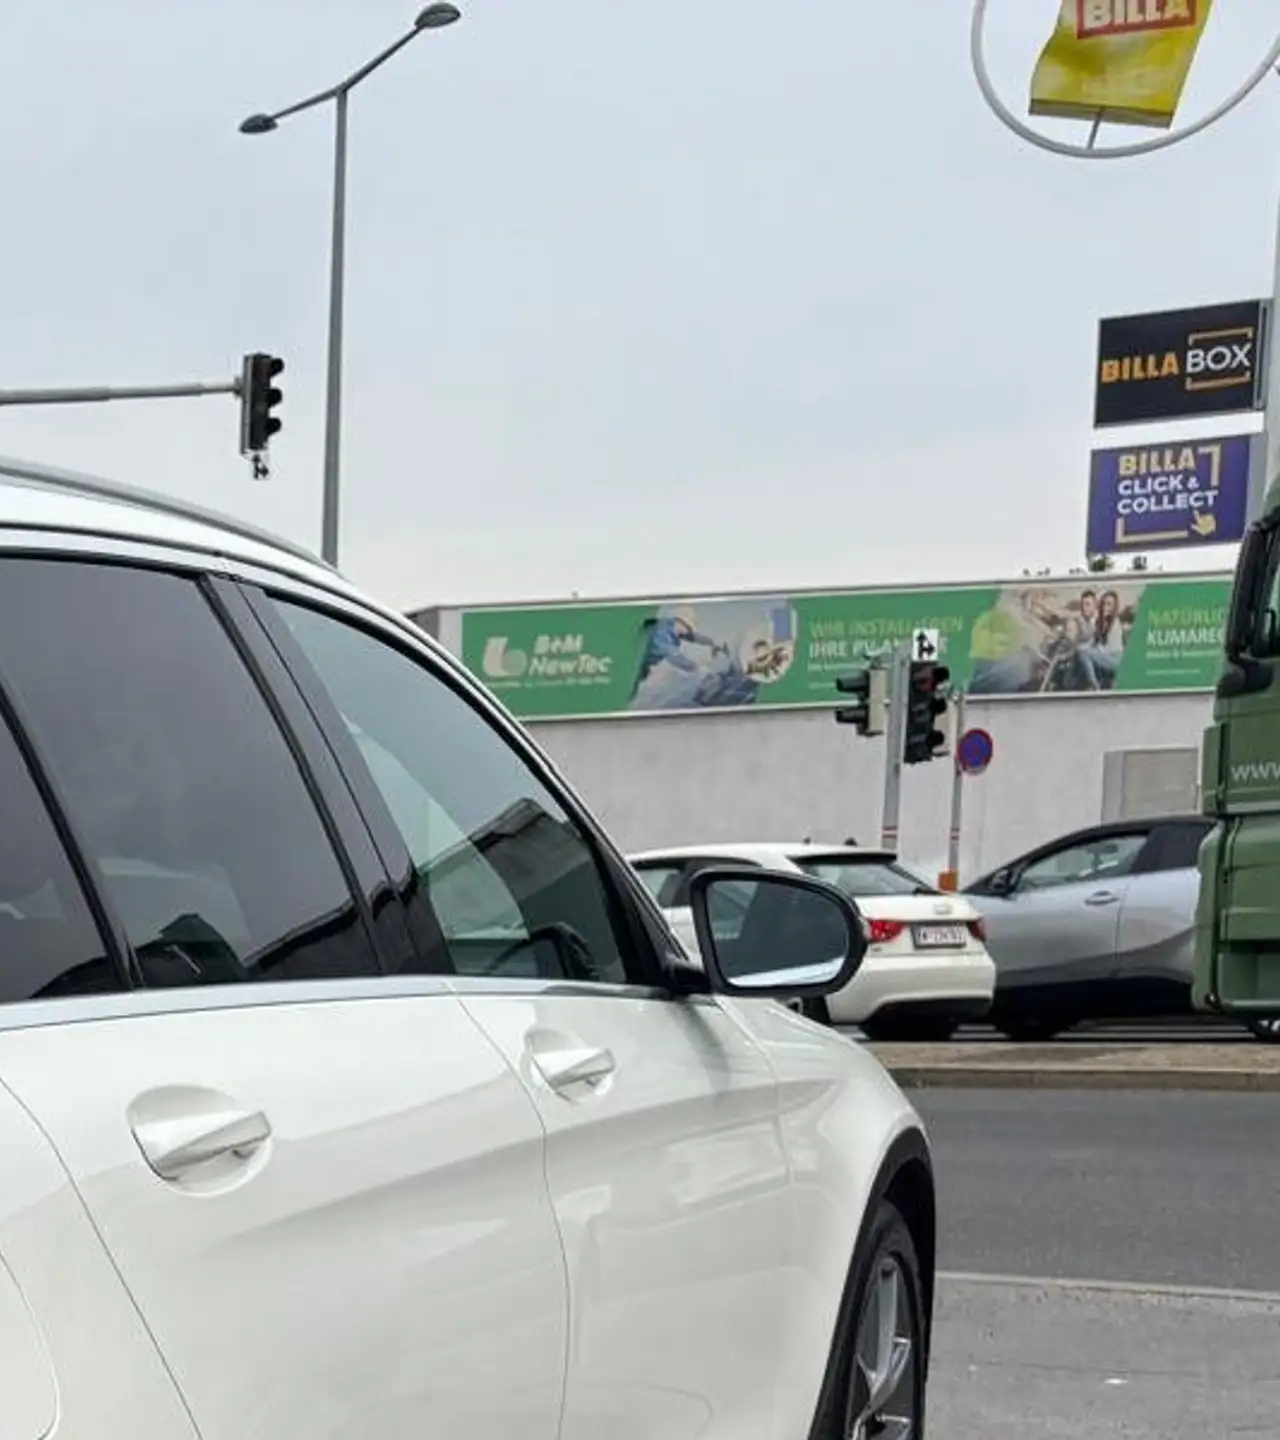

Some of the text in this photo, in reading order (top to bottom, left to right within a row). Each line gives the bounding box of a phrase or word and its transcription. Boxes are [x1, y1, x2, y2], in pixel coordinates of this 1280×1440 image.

[1083, 0, 1190, 30] BILLA
[1101, 344, 1252, 383] BILLA BOX
[1118, 446, 1196, 476] BILLA
[1118, 474, 1200, 496] CLICK &
[1117, 490, 1219, 514] COLLECT
[528, 653, 613, 676] NewTec
